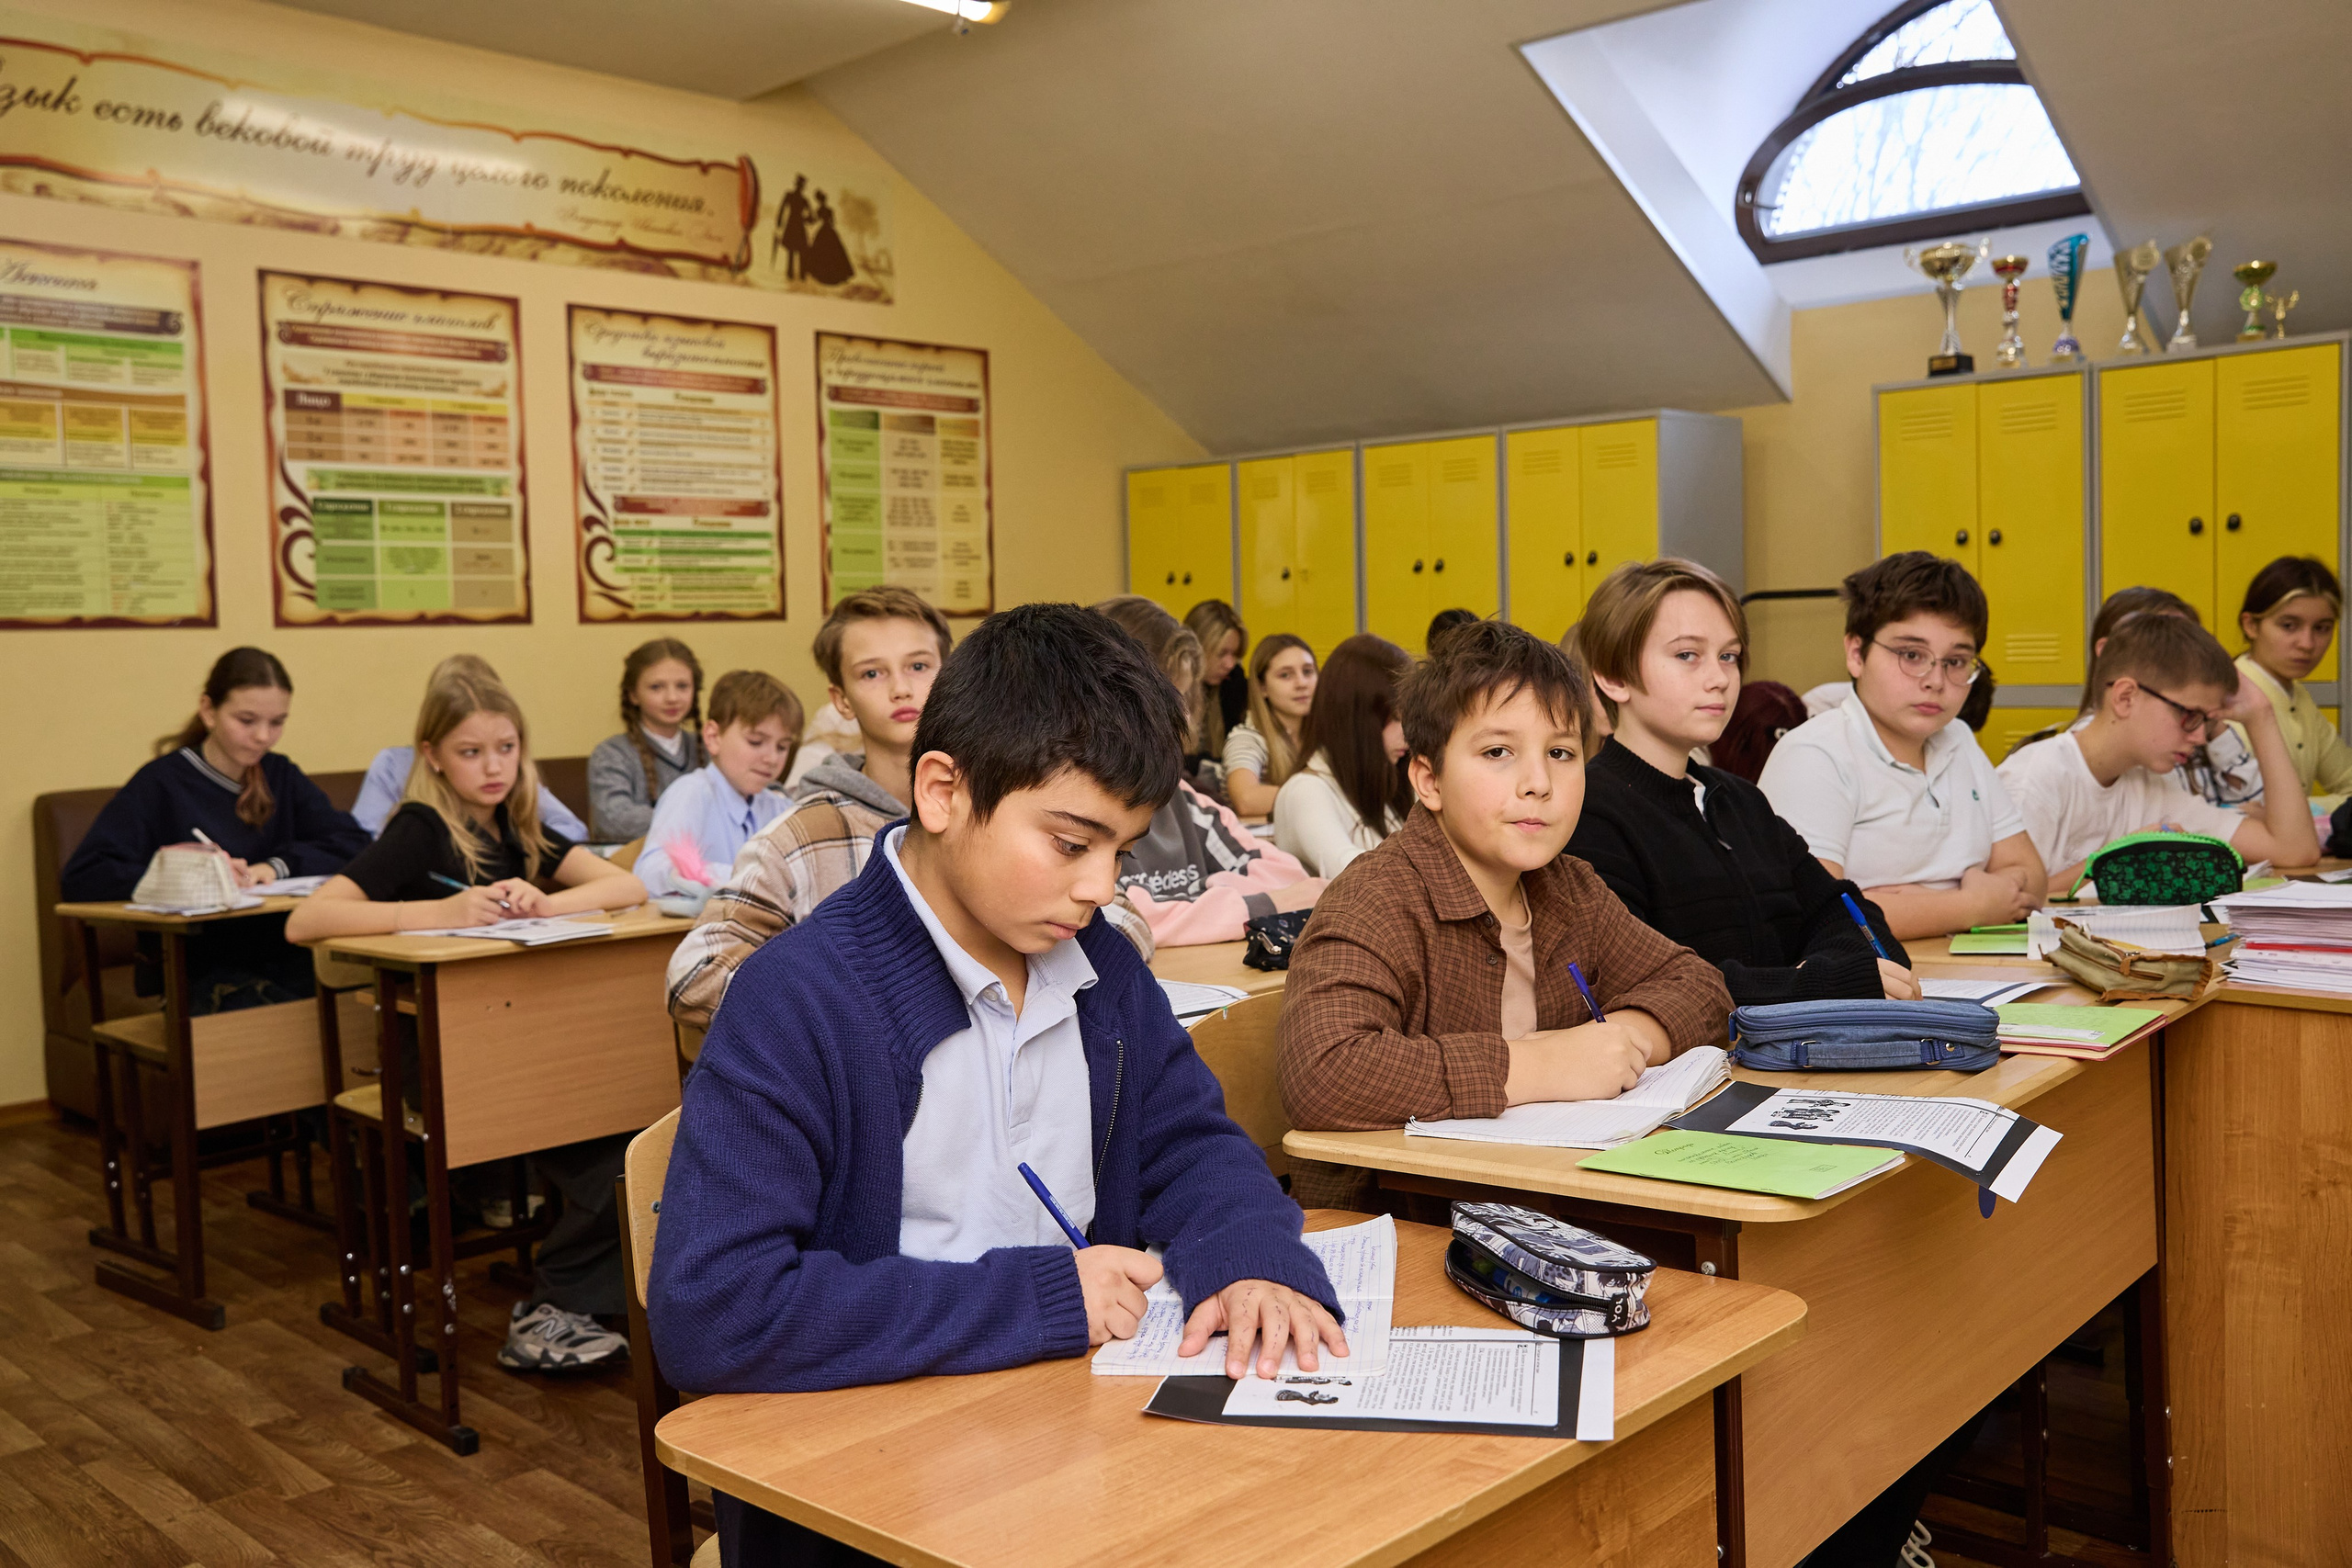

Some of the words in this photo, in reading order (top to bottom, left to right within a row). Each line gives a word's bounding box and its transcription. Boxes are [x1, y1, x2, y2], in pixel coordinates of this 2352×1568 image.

[0, 57, 83, 118] зык
[94, 98, 185, 133] есть
[195, 98, 334, 158] вековой
